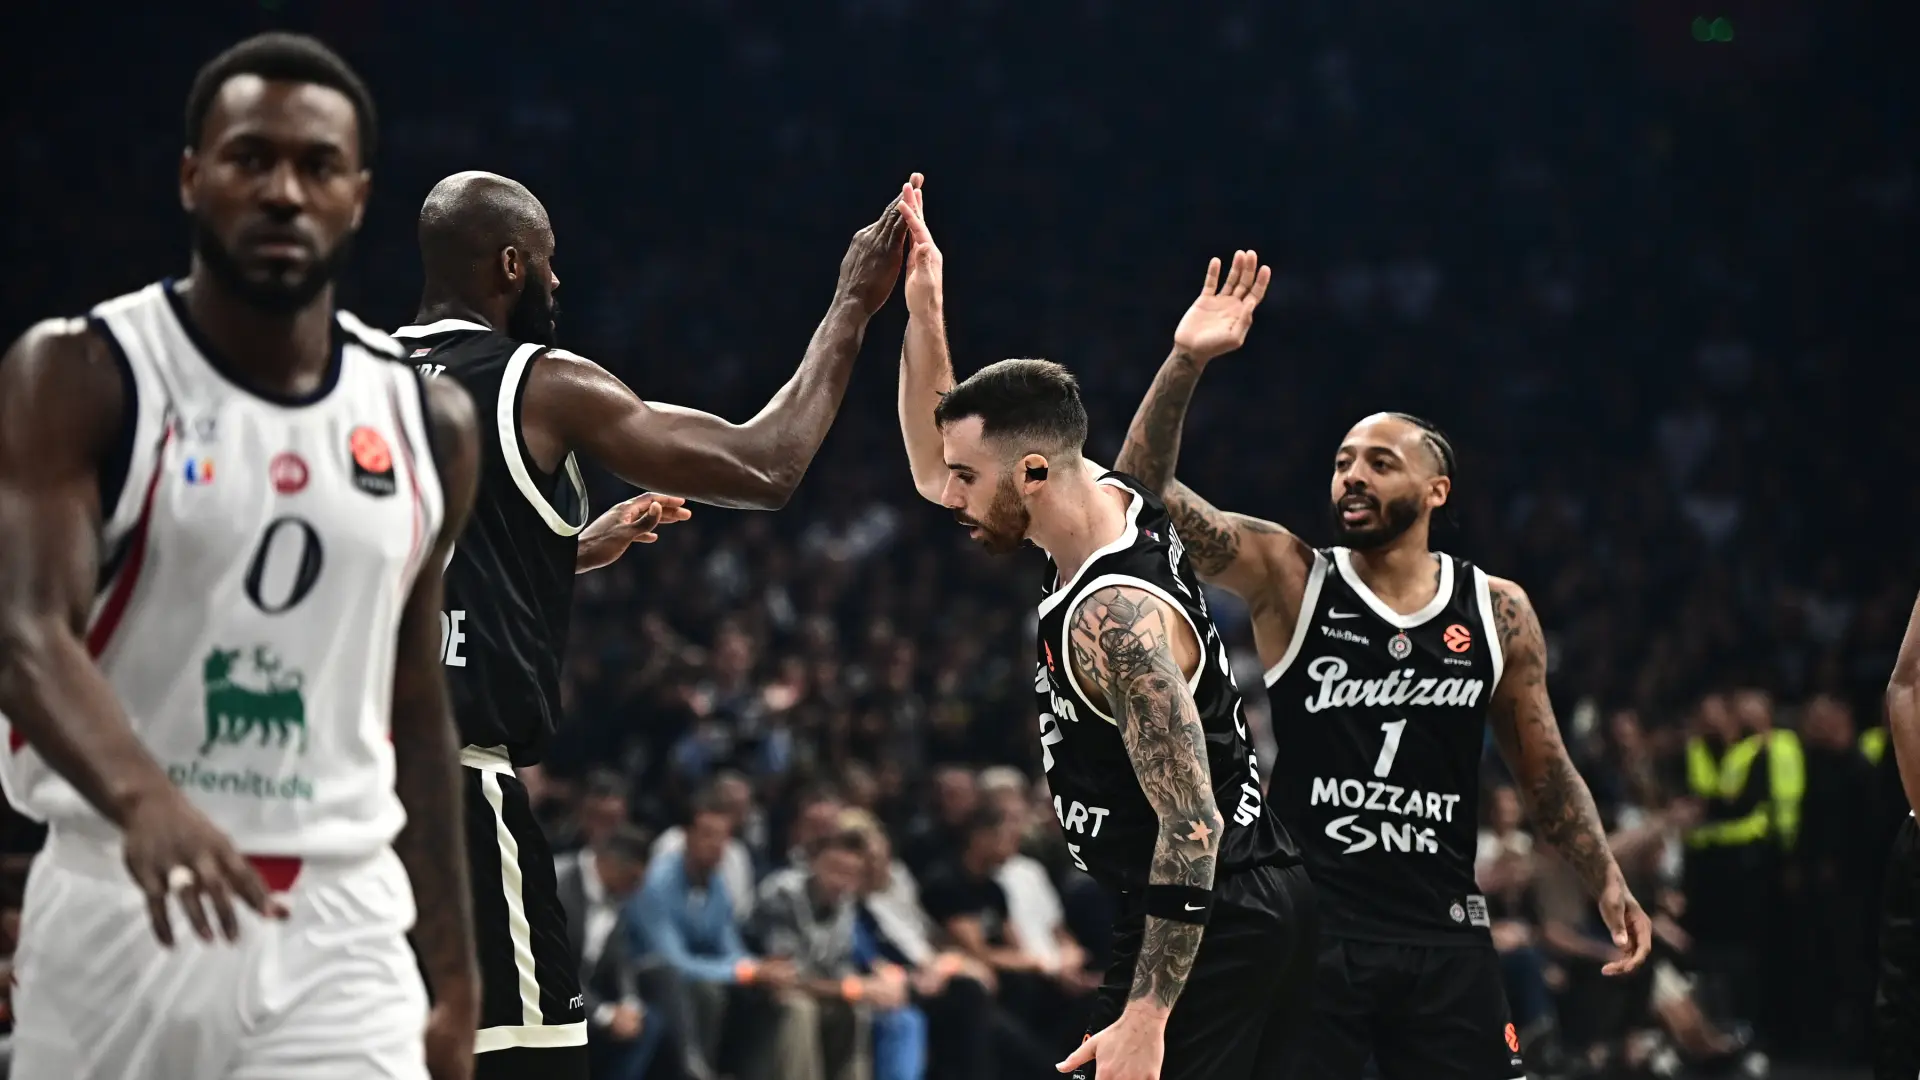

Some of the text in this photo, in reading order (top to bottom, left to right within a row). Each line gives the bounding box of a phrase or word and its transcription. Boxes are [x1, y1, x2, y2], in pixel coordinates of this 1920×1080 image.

[244, 514, 324, 618] 0
[1304, 655, 1484, 713] Partizan
[1374, 718, 1407, 778] 1
[1310, 776, 1461, 823] MOZZART
